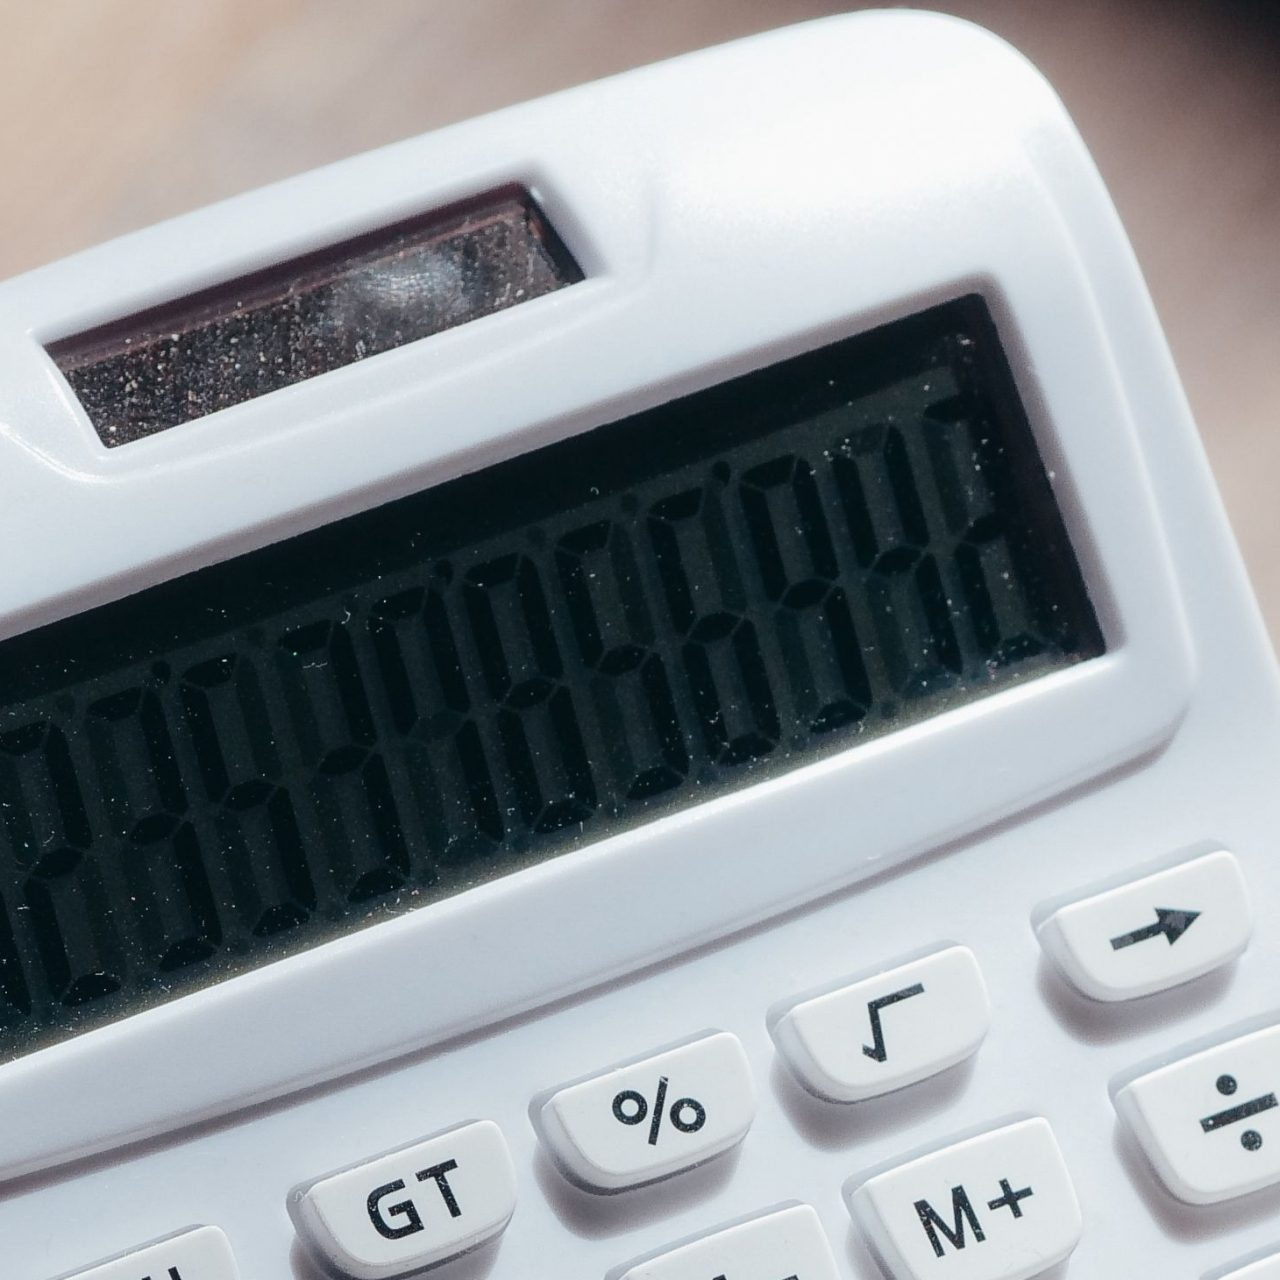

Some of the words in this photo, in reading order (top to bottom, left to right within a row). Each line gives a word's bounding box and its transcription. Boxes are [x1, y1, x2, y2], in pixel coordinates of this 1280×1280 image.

[612, 1081, 706, 1146] %
[366, 1158, 462, 1240] GT
[914, 1179, 1033, 1258] M+
